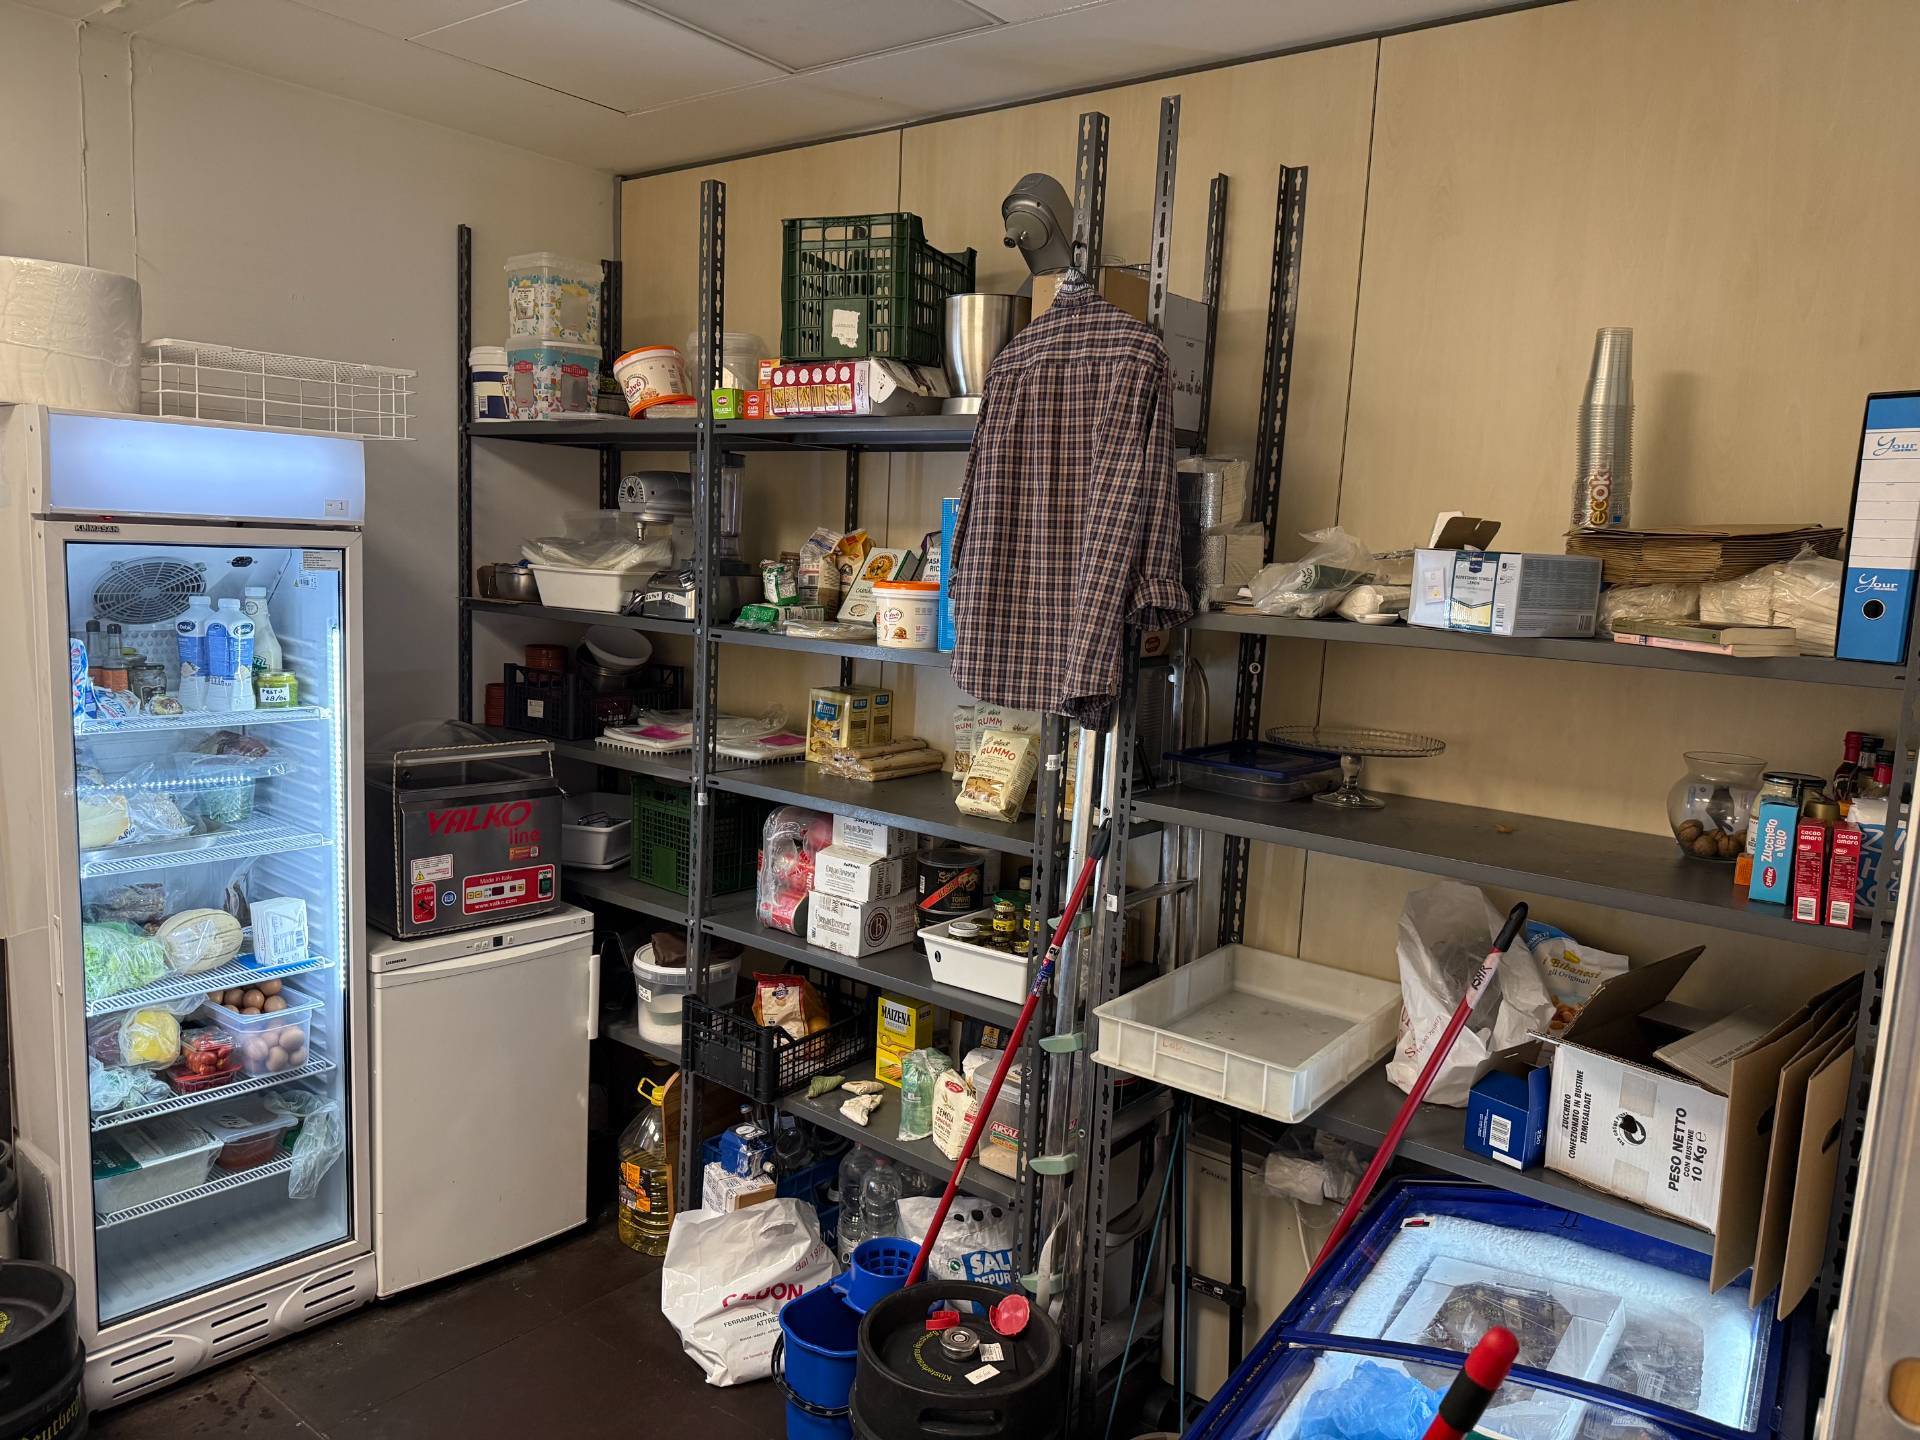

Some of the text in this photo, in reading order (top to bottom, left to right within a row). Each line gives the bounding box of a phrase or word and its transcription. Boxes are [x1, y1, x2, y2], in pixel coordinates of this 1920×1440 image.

[1873, 435, 1918, 456] Your
[1855, 573, 1898, 593] Your
[955, 722, 973, 730] RUM
[978, 717, 1003, 727] RUMM
[980, 746, 1016, 761] RUMMO
[427, 800, 534, 836] VALKO
[509, 828, 541, 845] line
[1760, 818, 1778, 862] Zucchero
[1774, 829, 1786, 851] Velo
[1550, 958, 1602, 978] Bibanesi
[1558, 970, 1591, 985] Originali
[881, 1005, 911, 1027] MAIZENA
[1562, 1094, 1571, 1130] ZUCCHERO
[1568, 1069, 1584, 1159] CONFEZIONATO IN BUSTINE
[1580, 1092, 1592, 1144] TERMOSALDATE
[1668, 1107, 1687, 1192] PESO NETTO
[1683, 1129, 1694, 1178] CON BUSTINE
[1695, 1145, 1707, 1164] Kg
[1691, 1166, 1703, 1182] 10
[723, 1311, 767, 1327] FERRAMENTA
